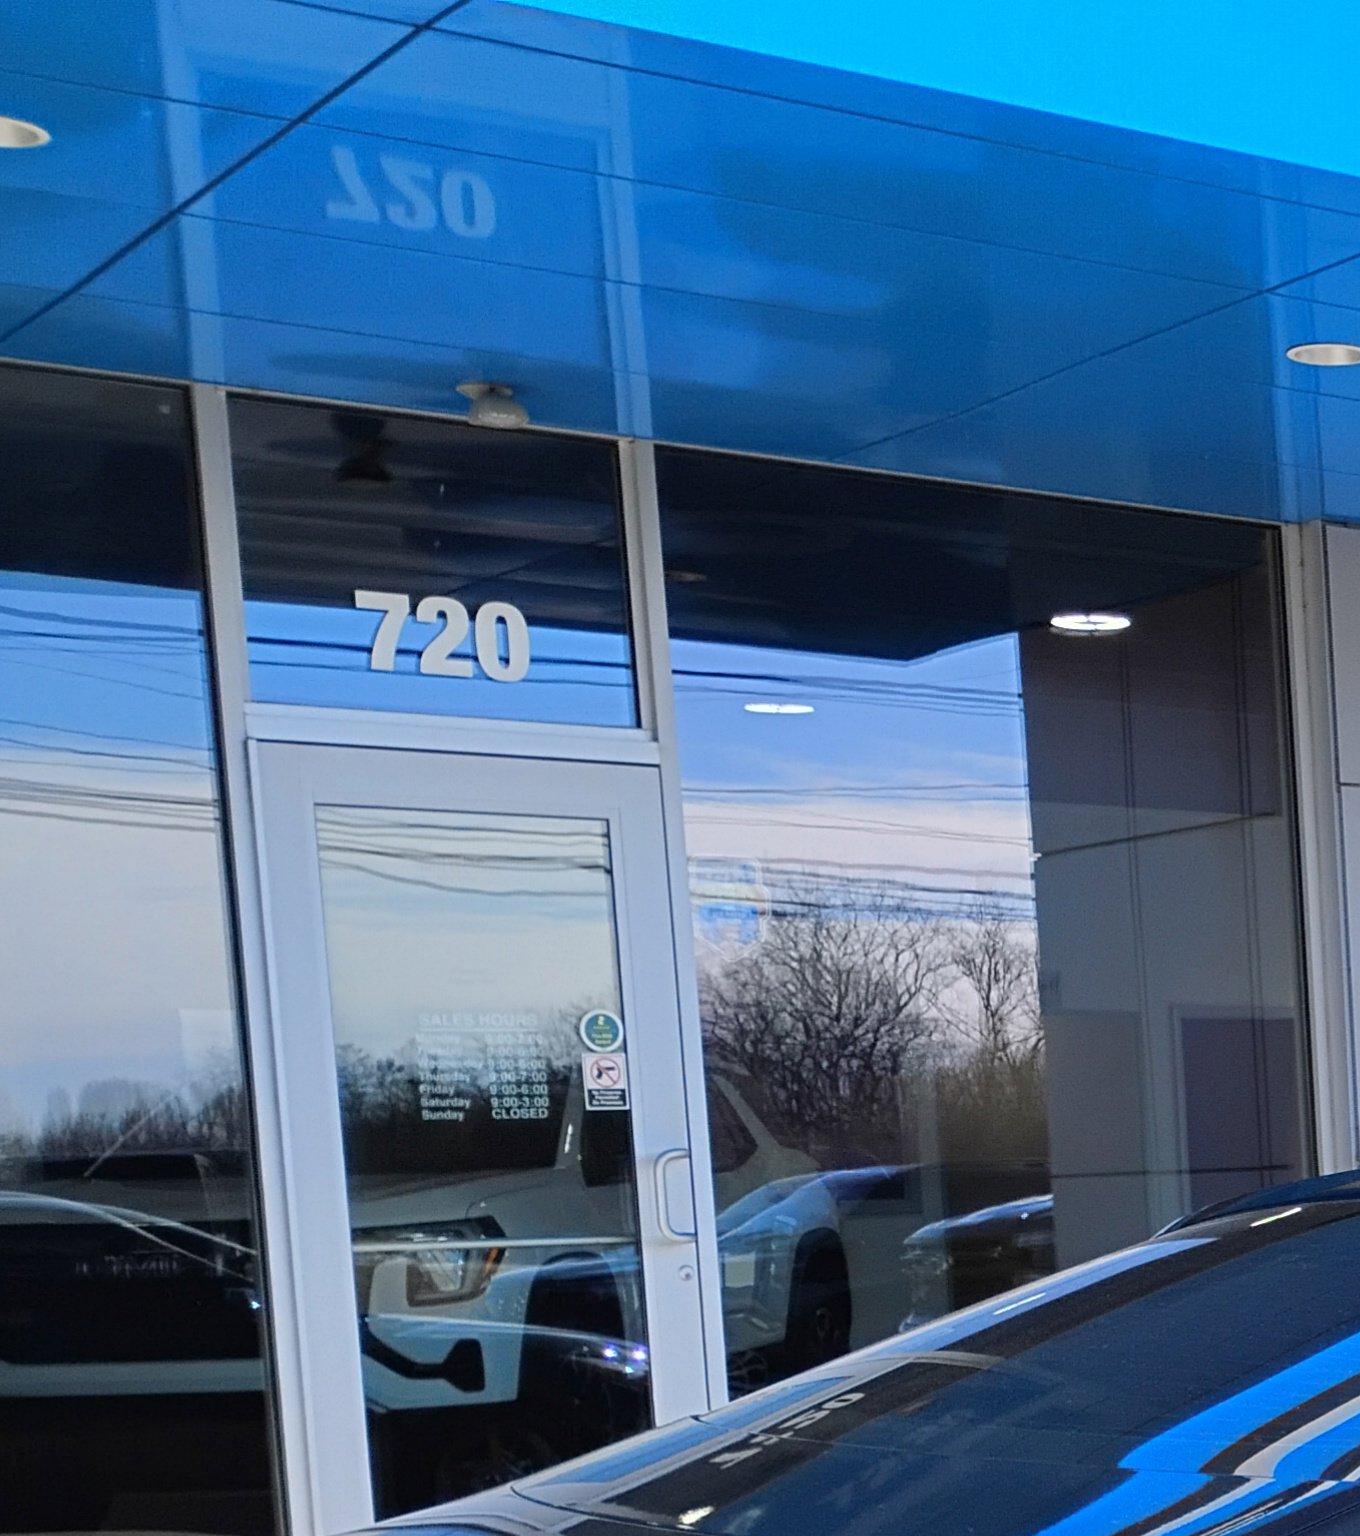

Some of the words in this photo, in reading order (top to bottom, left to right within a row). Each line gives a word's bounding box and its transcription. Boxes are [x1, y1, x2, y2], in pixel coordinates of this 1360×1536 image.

[354, 589, 531, 682] 720
[418, 1013, 475, 1027] SALES
[479, 1013, 538, 1027] HOURS
[419, 1072, 471, 1084] Thursday
[419, 1084, 456, 1096] Friday
[489, 1084, 548, 1096] 9:00-6:00
[420, 1096, 471, 1109] Saturday
[490, 1096, 549, 1108] 9:00-3:00
[421, 1109, 465, 1122] Sunday
[492, 1108, 549, 1120] CLOSED
